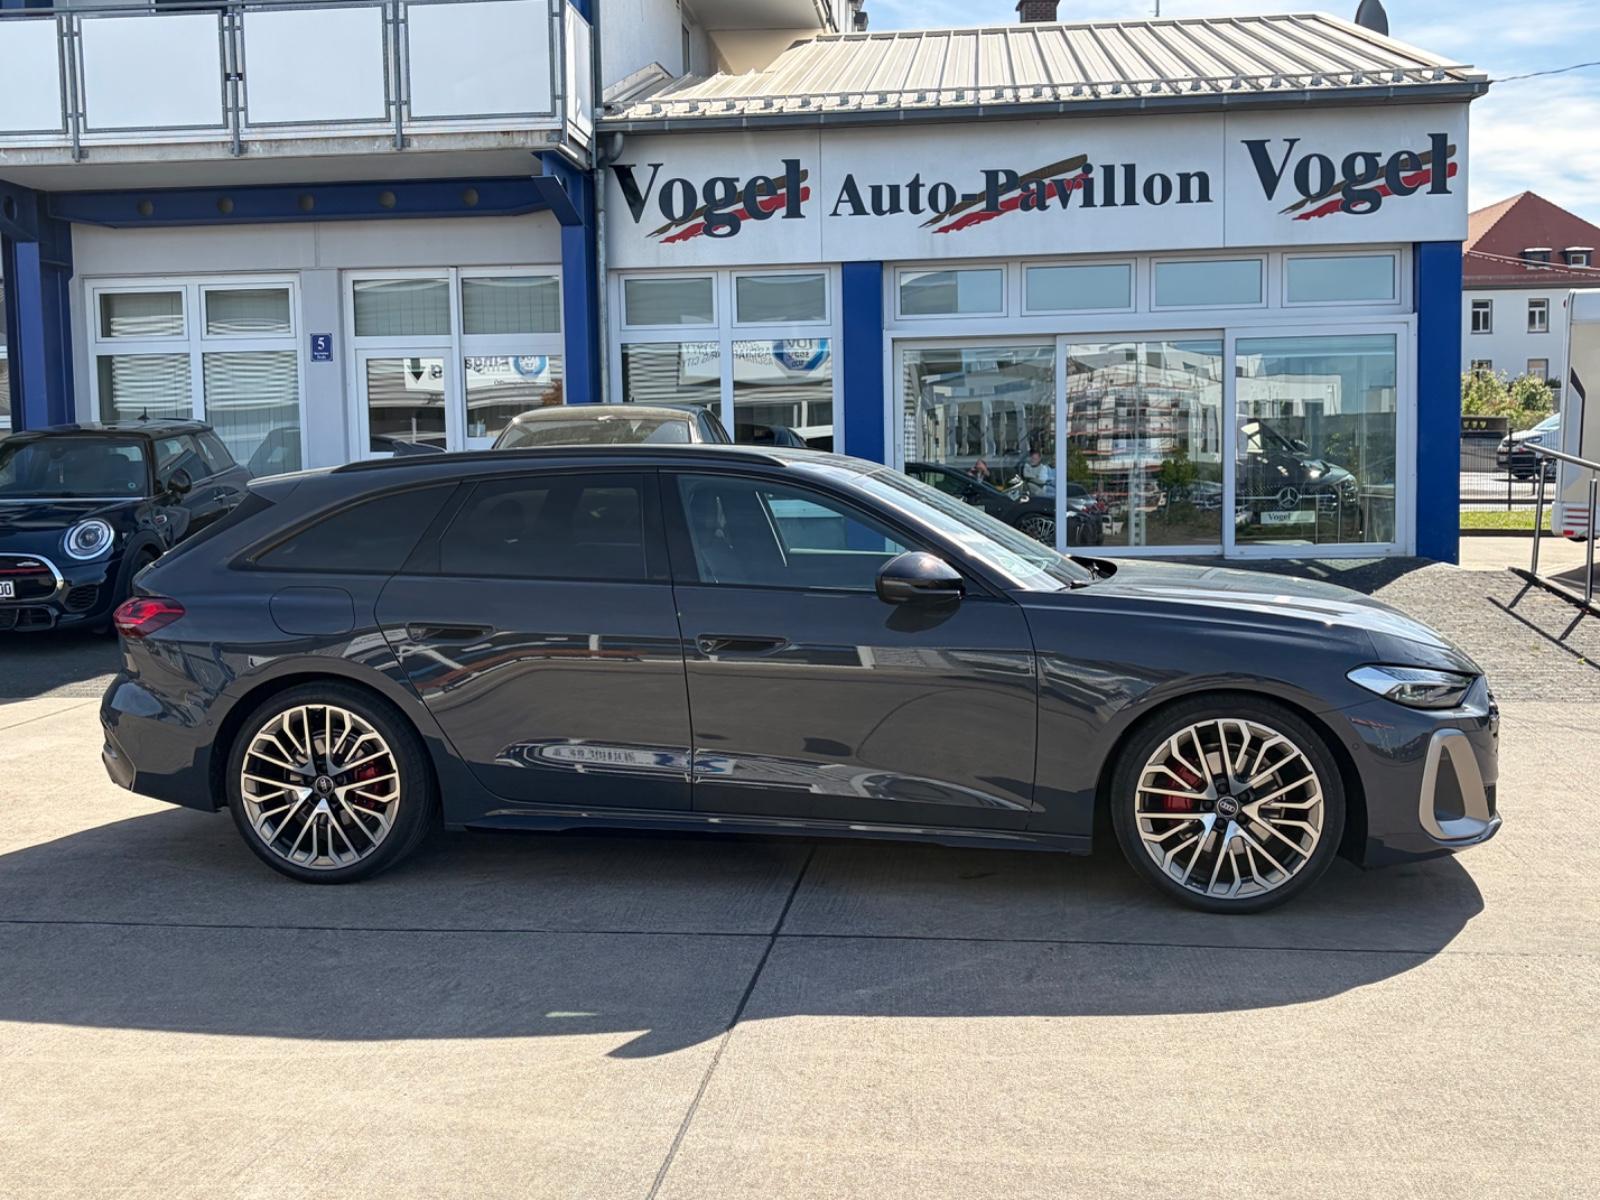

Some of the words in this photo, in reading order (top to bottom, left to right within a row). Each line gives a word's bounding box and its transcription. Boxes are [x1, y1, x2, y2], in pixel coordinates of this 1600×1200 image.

[608, 159, 806, 238] Vogel
[829, 163, 1214, 217] Auto-Pavillon
[1240, 133, 1453, 215] Vogel
[317, 336, 325, 350] 5
